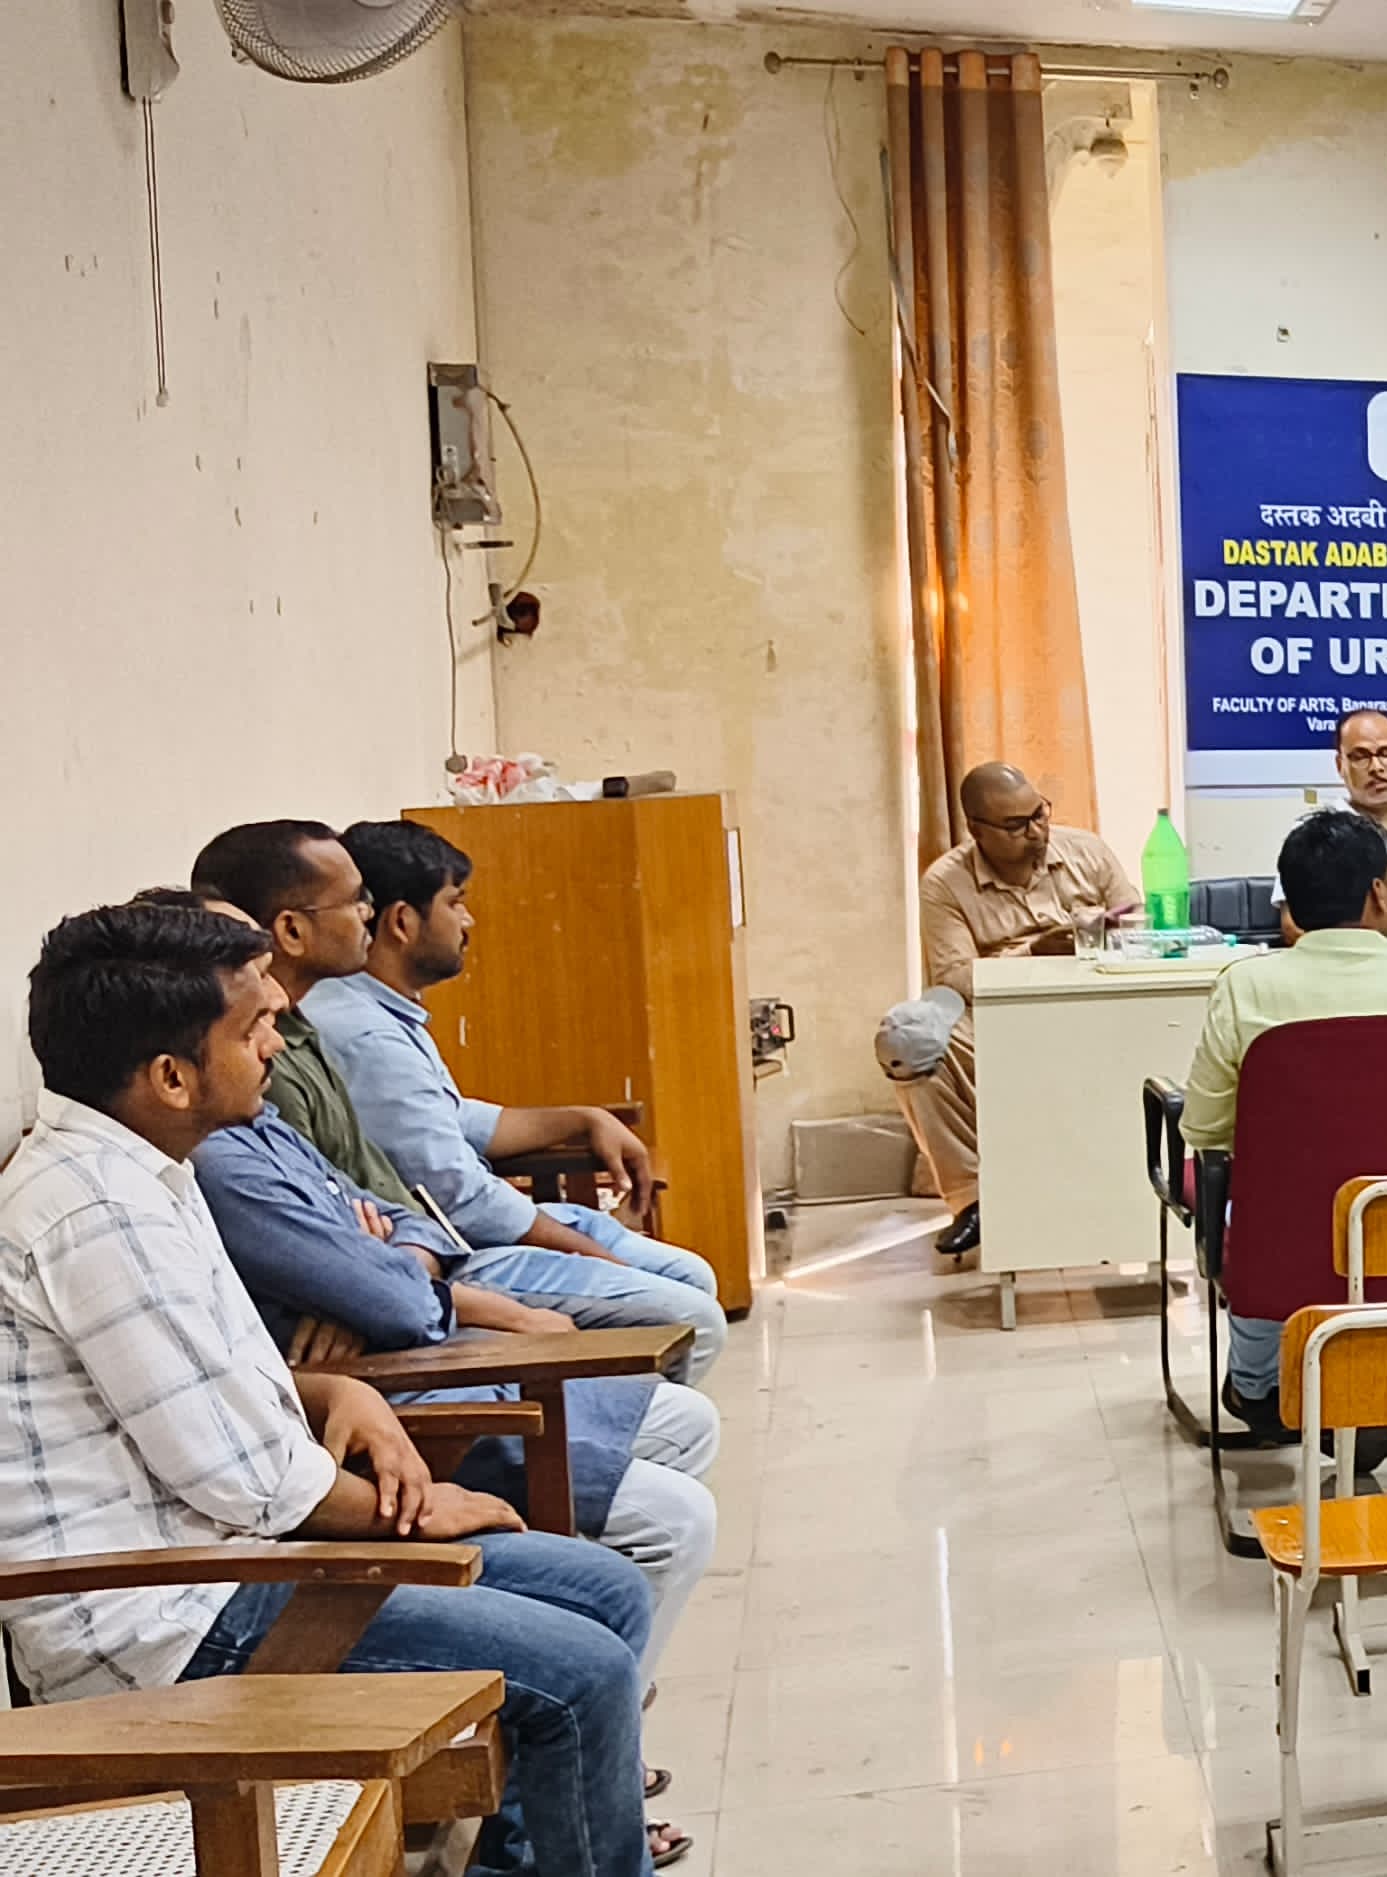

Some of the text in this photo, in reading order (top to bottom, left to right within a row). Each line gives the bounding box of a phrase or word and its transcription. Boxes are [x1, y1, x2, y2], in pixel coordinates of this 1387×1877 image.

[1260, 504, 1322, 528] दस्तक
[1223, 539, 1319, 567] DASTAK
[1250, 636, 1313, 675] OF
[1213, 697, 1273, 713] FACULTY
[1277, 698, 1296, 713] OF
[1299, 697, 1339, 715] ARTS,
